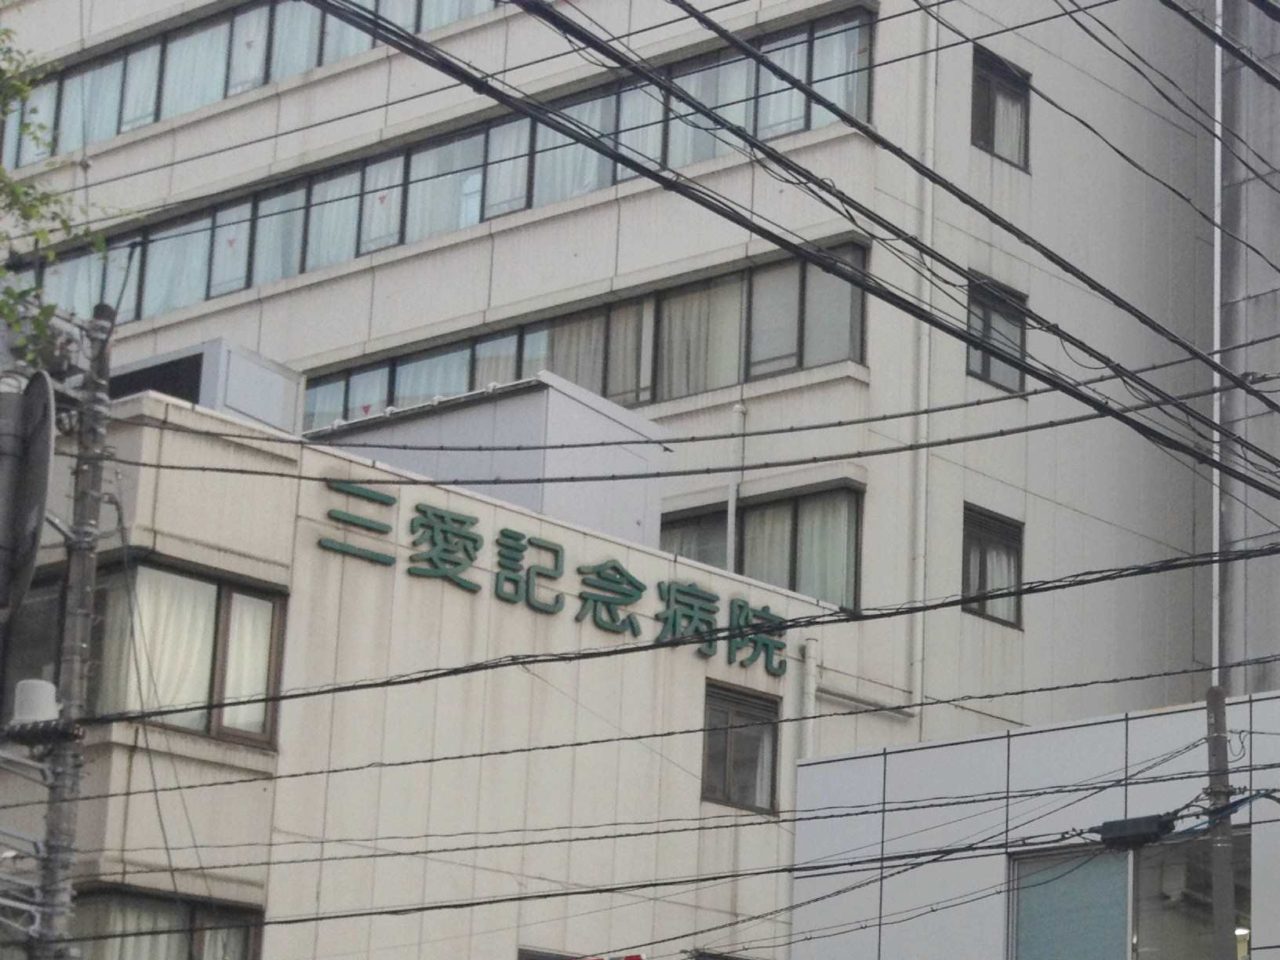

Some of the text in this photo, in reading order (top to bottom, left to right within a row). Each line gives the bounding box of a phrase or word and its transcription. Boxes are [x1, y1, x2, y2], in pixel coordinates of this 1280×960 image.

[318, 478, 787, 677] 三愛記念病院
